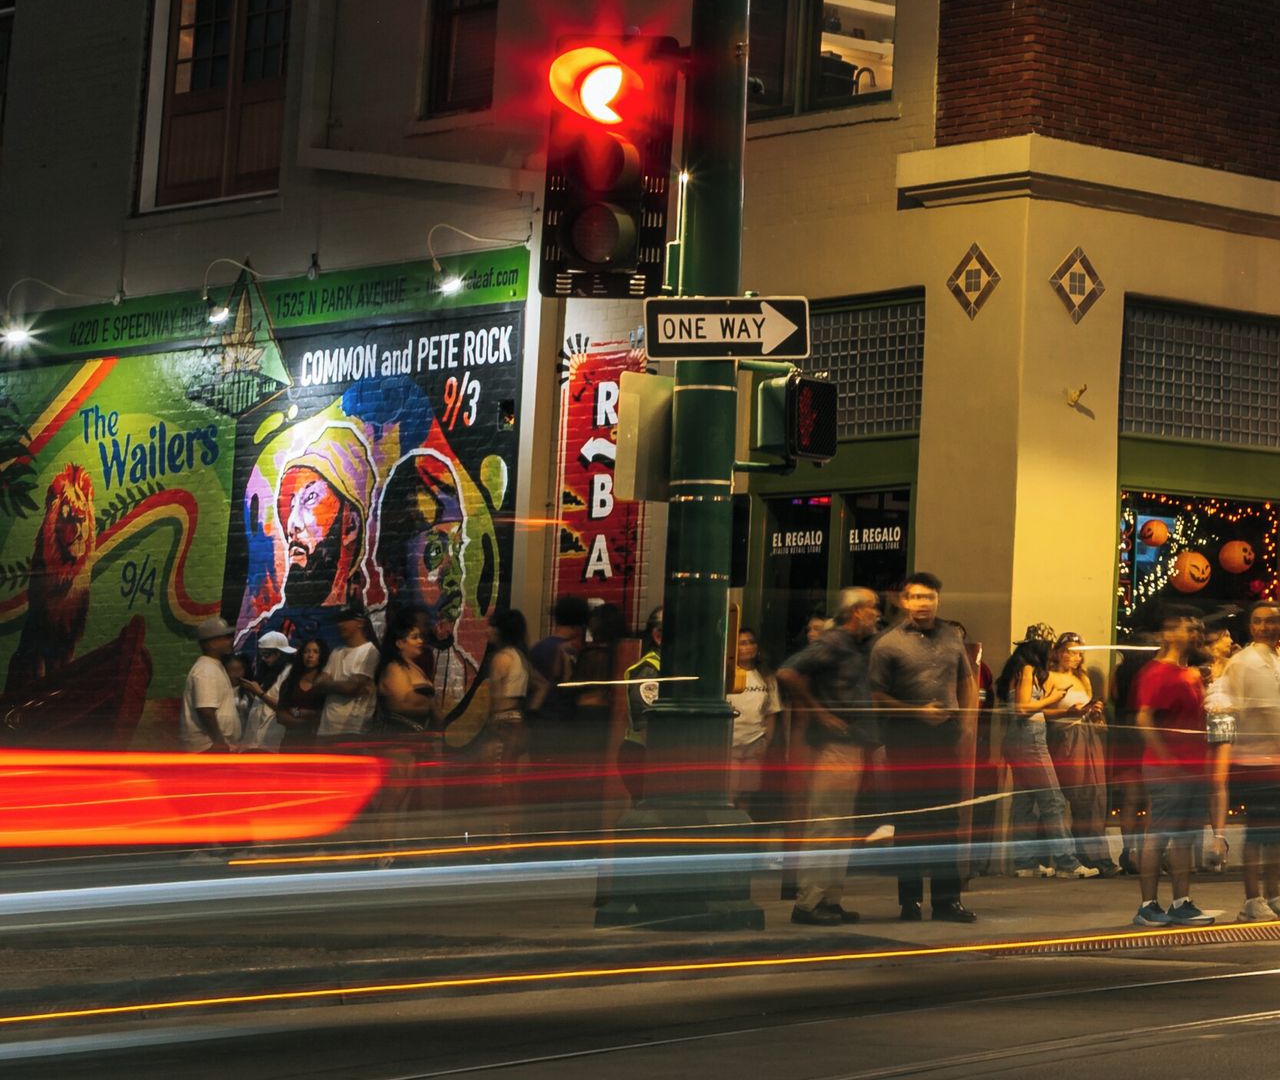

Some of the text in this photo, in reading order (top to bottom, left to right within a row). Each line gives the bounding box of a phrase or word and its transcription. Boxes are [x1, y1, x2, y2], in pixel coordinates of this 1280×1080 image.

[276, 292, 304, 318] 1525
[307, 291, 317, 315] N
[320, 285, 354, 312] PARK
[356, 278, 406, 306] AVENUE
[69, 320, 98, 346] 4220
[102, 318, 110, 341] E
[112, 309, 178, 341] SPEEDWAY
[663, 317, 766, 340] ONE WAY
[301, 326, 513, 387] COMMON and PETE ROCK
[442, 372, 481, 431] 9/3
[80, 405, 119, 444] The
[99, 421, 220, 490] Wailers
[772, 530, 823, 547] EL REGALO
[849, 526, 901, 544] EL REGALO
[121, 554, 156, 610] 9/4
